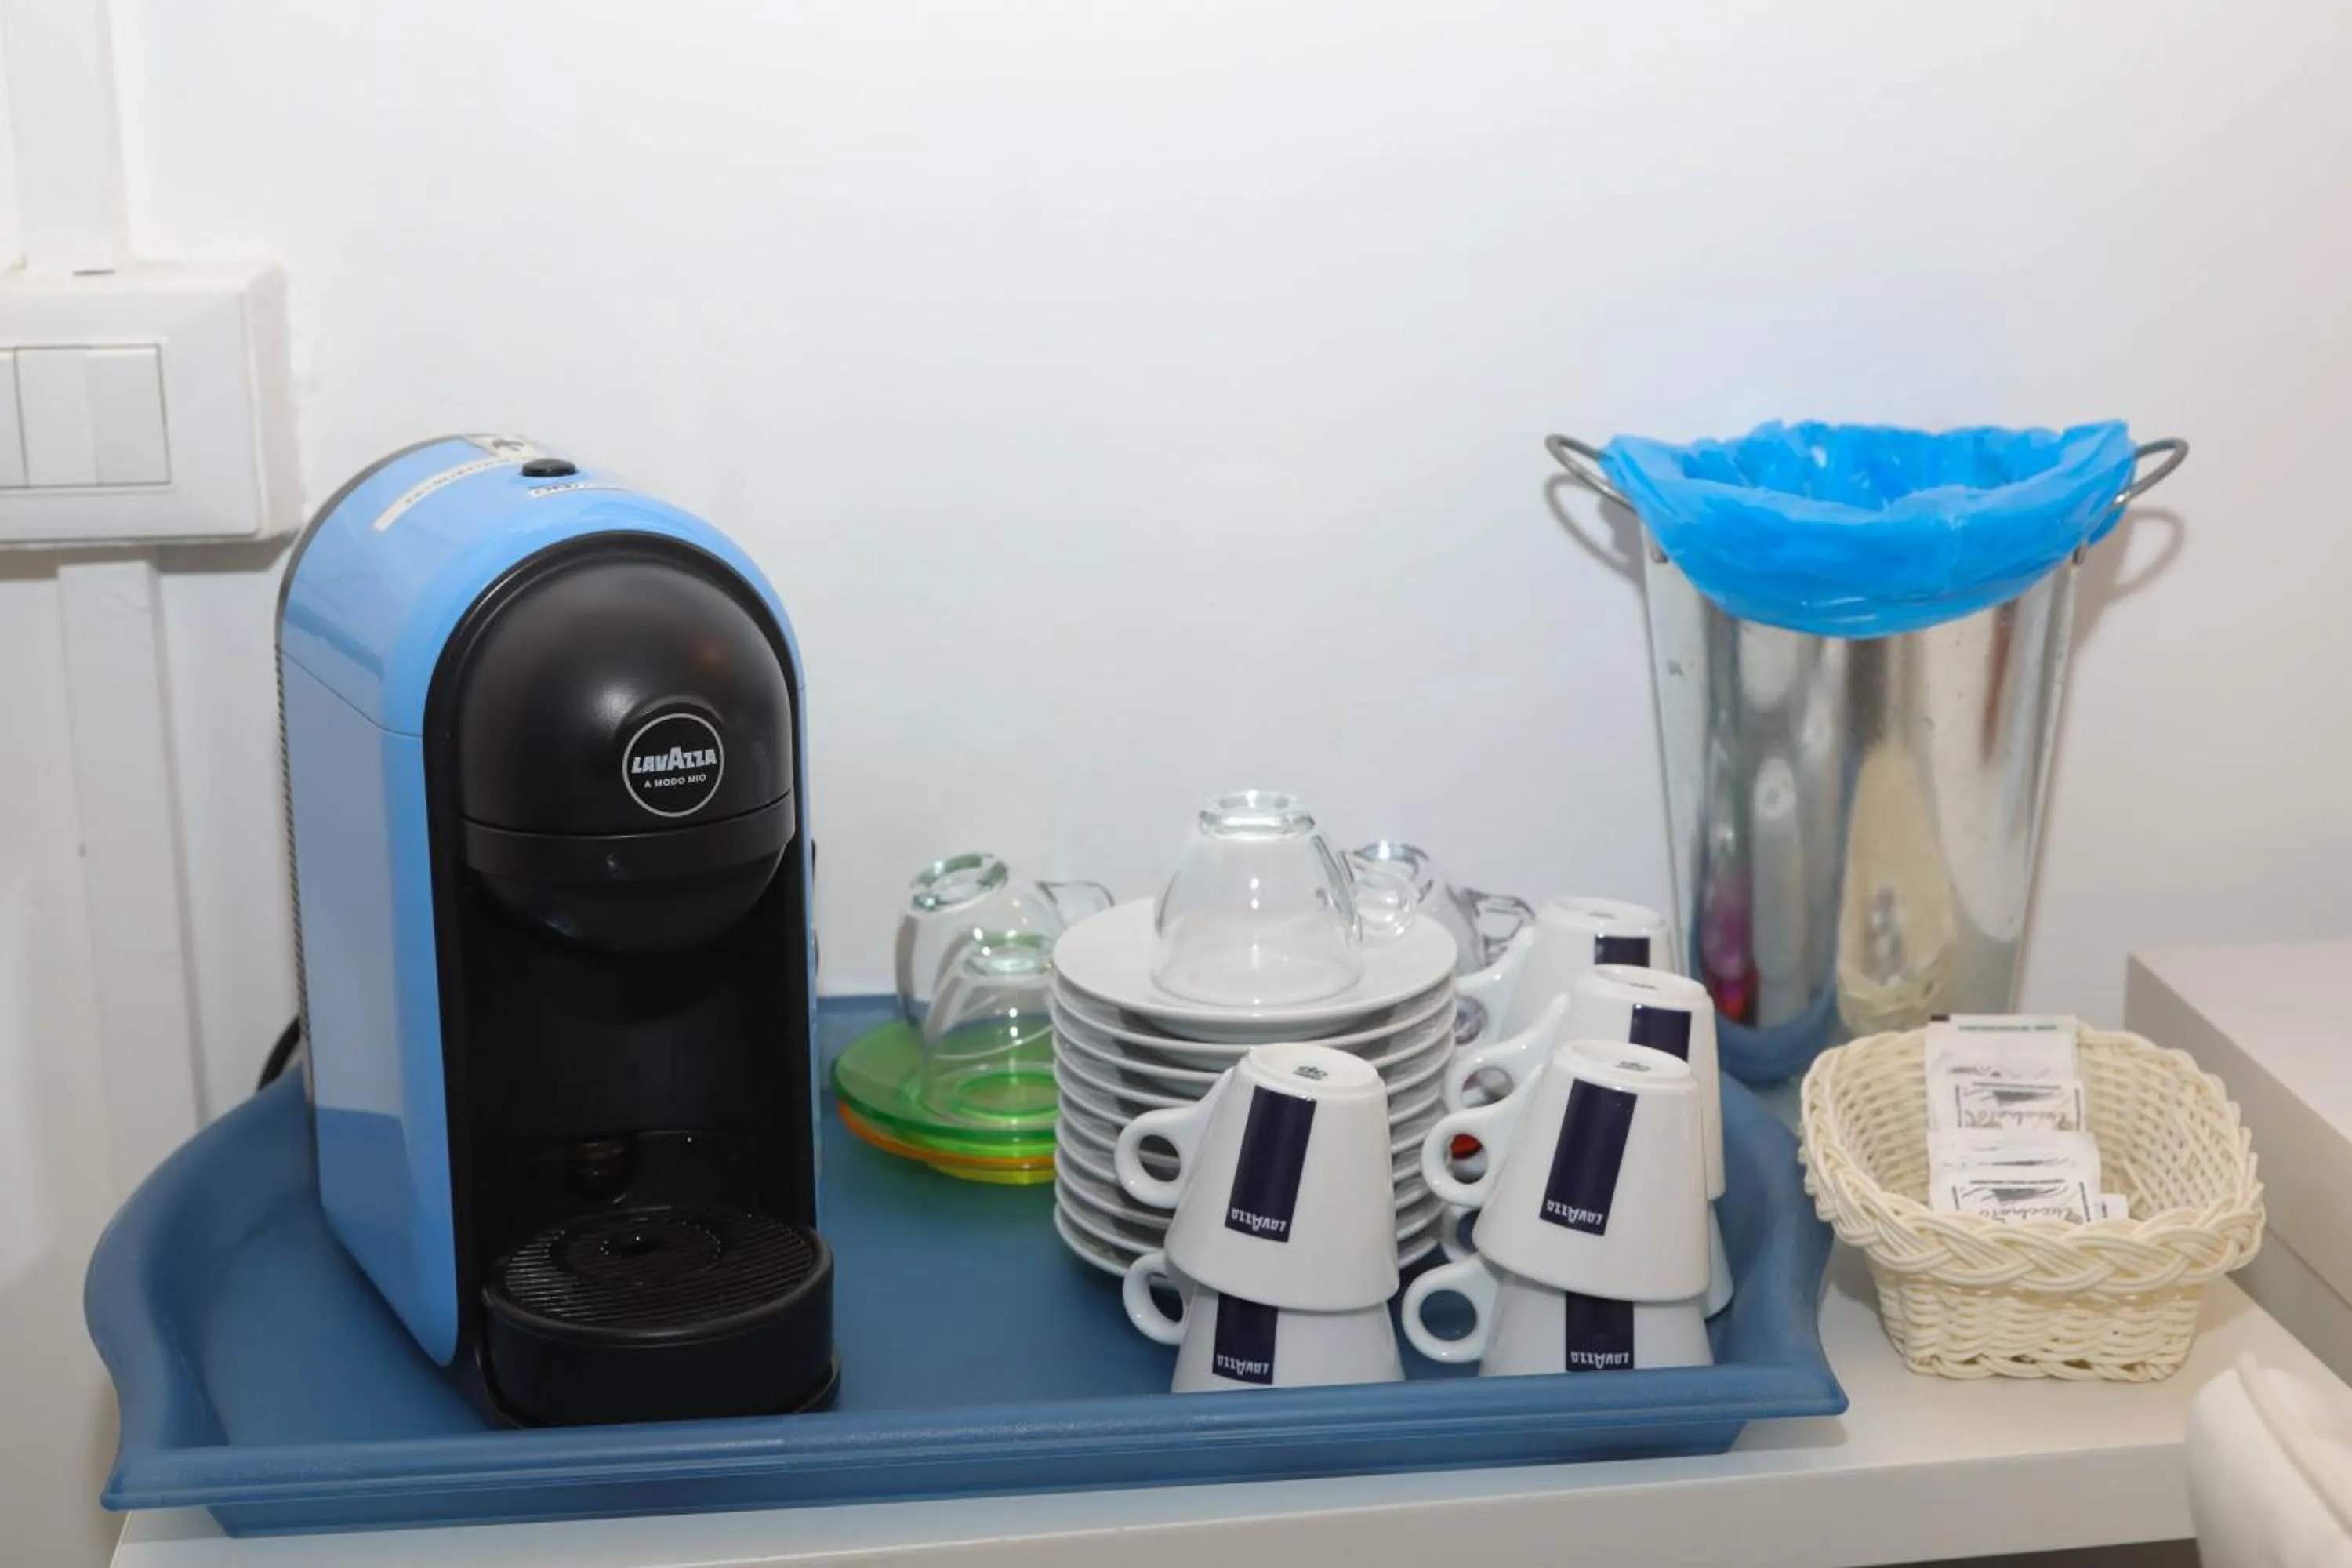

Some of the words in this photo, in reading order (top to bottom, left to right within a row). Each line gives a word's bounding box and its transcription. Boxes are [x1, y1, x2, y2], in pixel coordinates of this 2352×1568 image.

[631, 746, 717, 774] LAVAZZA
[654, 775, 685, 788] MODO
[1231, 1207, 1287, 1233] LAVAZZA
[1547, 1199, 1603, 1226] LAVAZZA
[1217, 1354, 1269, 1376] LAVAZZA
[1570, 1351, 1630, 1370] LAVAZZA
